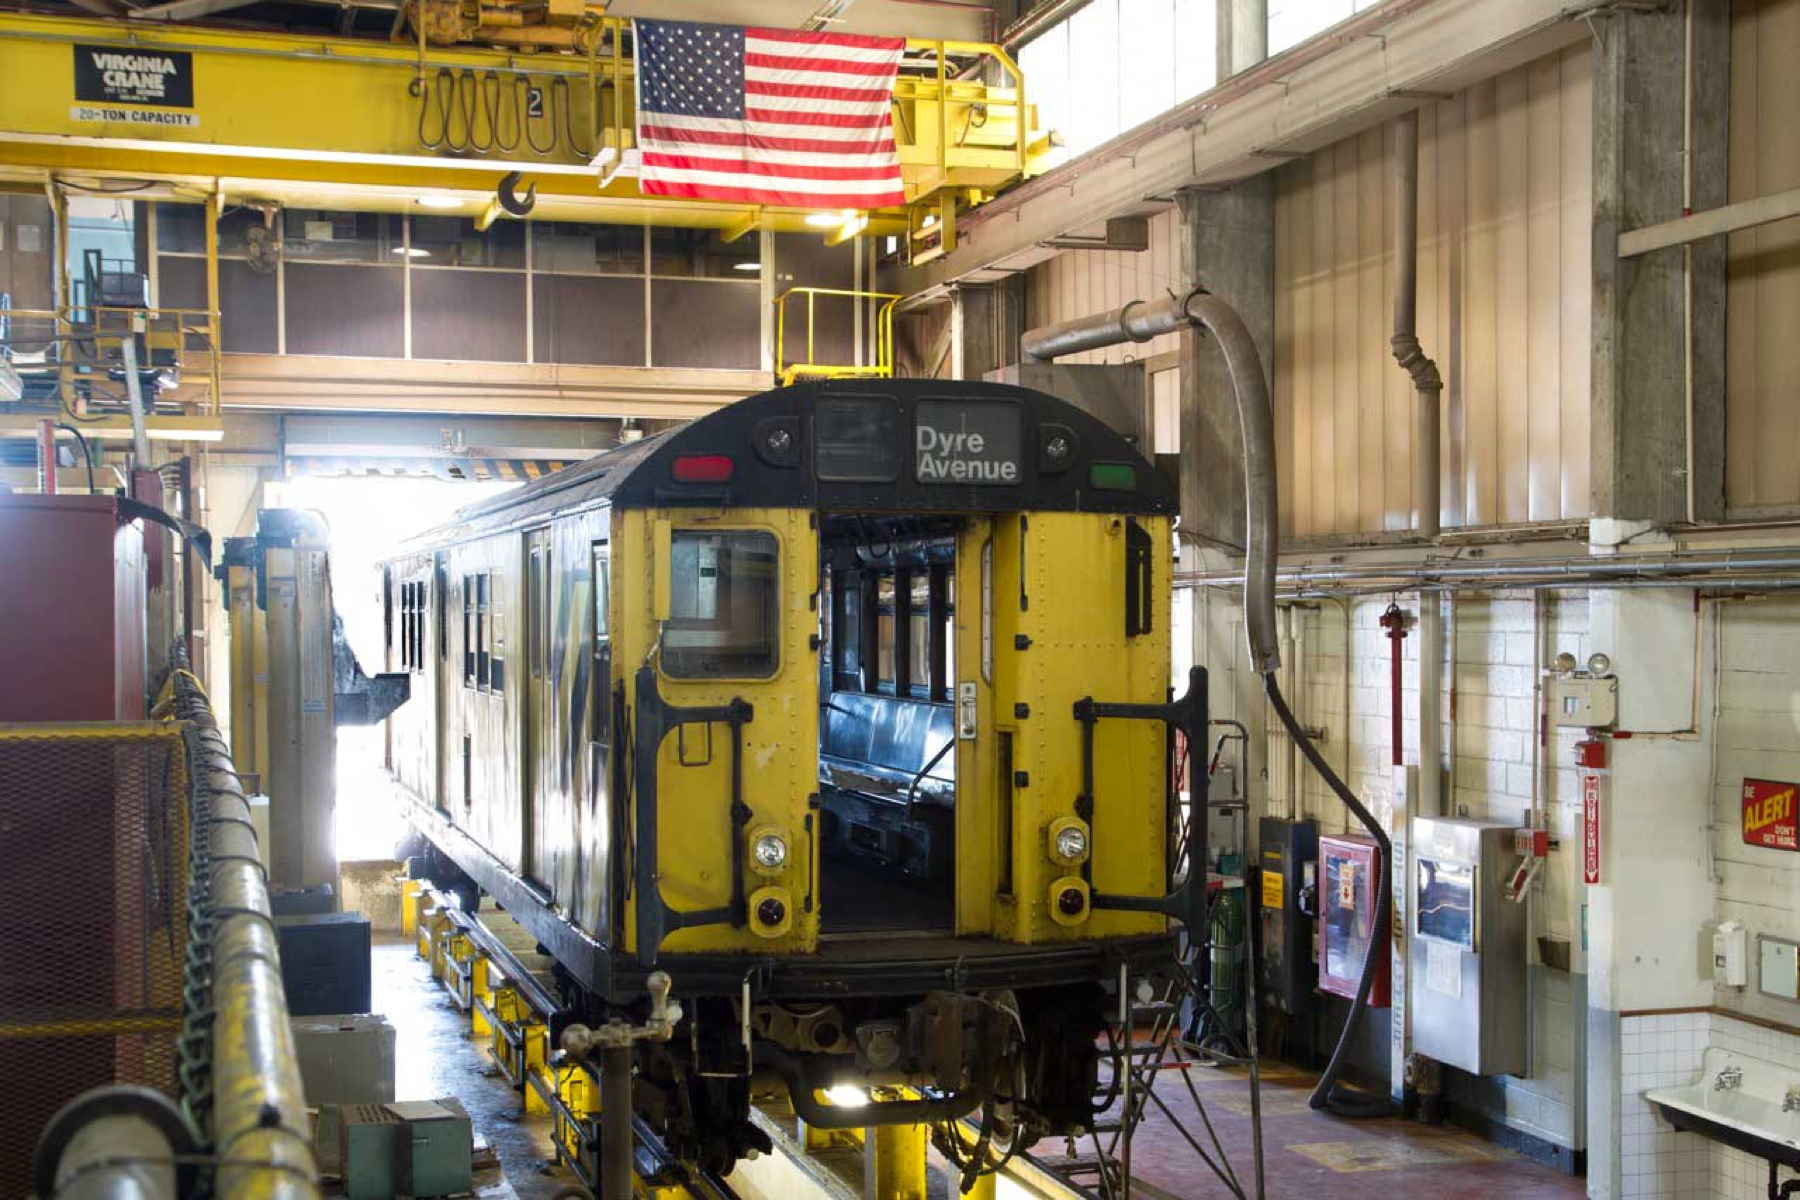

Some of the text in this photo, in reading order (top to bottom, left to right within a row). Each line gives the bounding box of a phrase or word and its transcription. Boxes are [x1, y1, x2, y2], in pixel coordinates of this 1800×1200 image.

[91, 52, 177, 75] VIRGINIA
[103, 70, 165, 89] CRANE
[528, 90, 541, 116] 2
[79, 109, 192, 124] 20-TON CAPACITY
[916, 425, 984, 456] Dyre
[918, 453, 1016, 480] Avenue
[1744, 787, 1794, 833] ALERT
